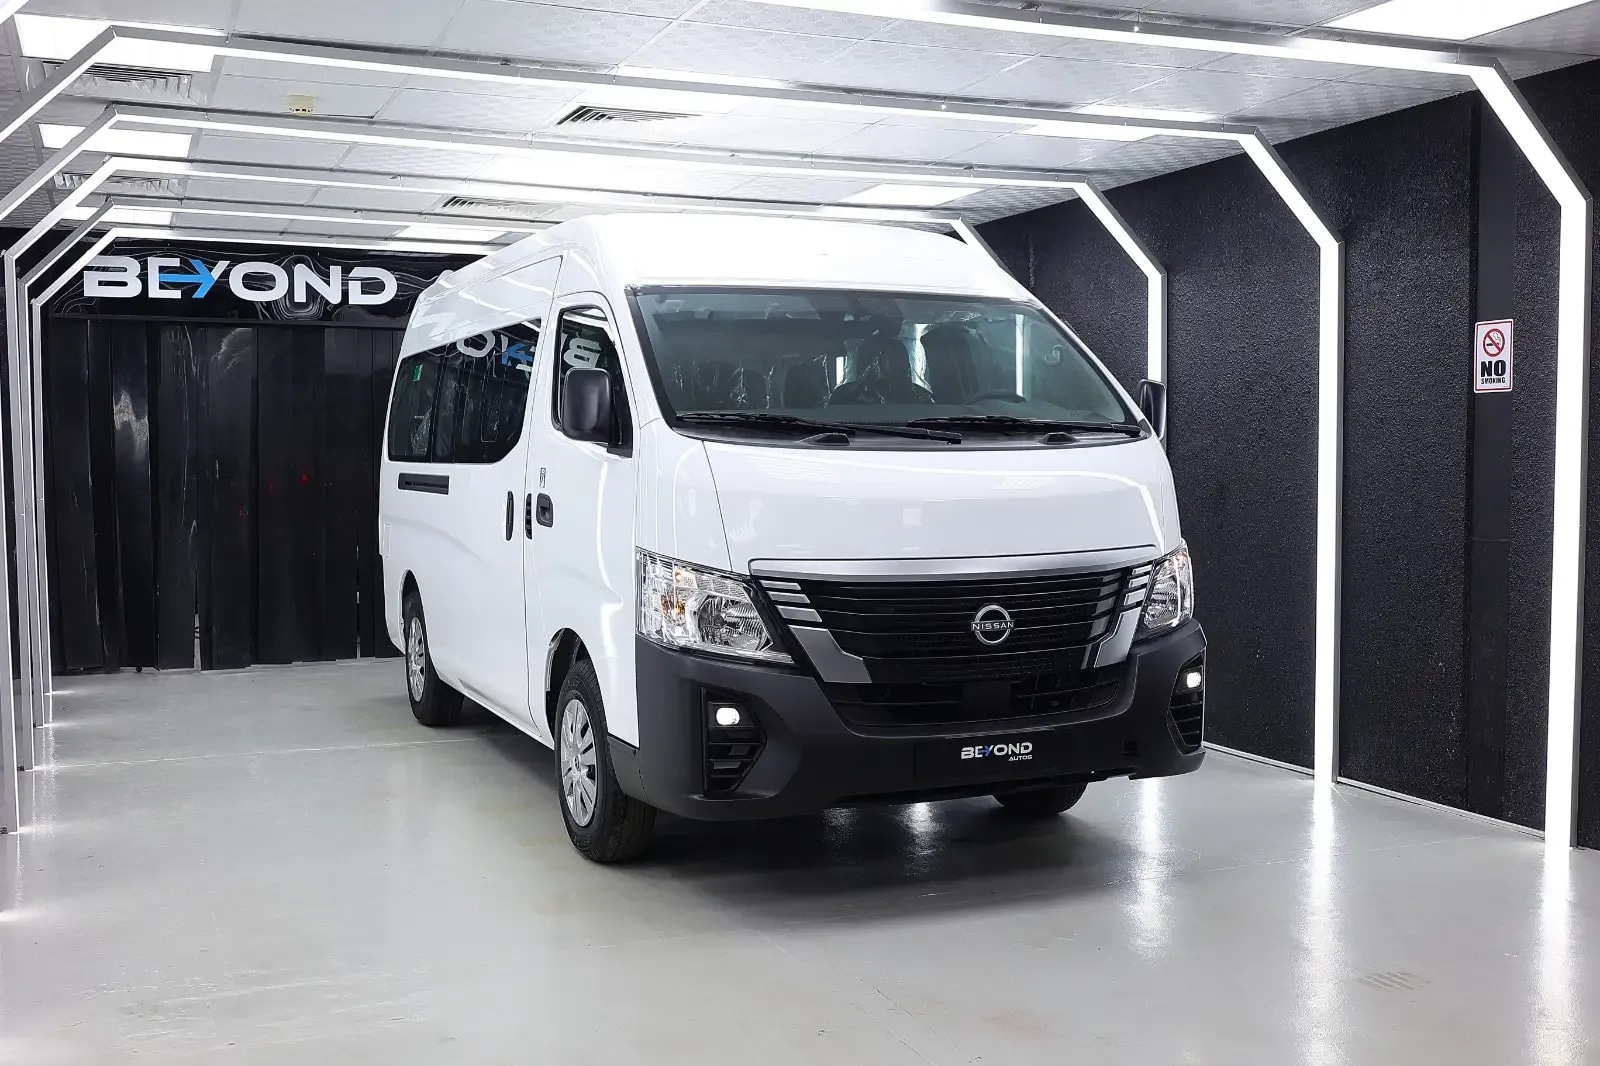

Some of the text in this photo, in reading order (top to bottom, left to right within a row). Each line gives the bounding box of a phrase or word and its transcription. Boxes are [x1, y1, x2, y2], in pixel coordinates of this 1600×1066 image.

[84, 254, 398, 305] BEYOND
[1480, 360, 1507, 377] NO
[1480, 377, 1506, 385] SMOKING
[972, 621, 1014, 631] NISSAN
[961, 742, 1033, 760] BEYOND
[1008, 754, 1033, 762] AUTOS
